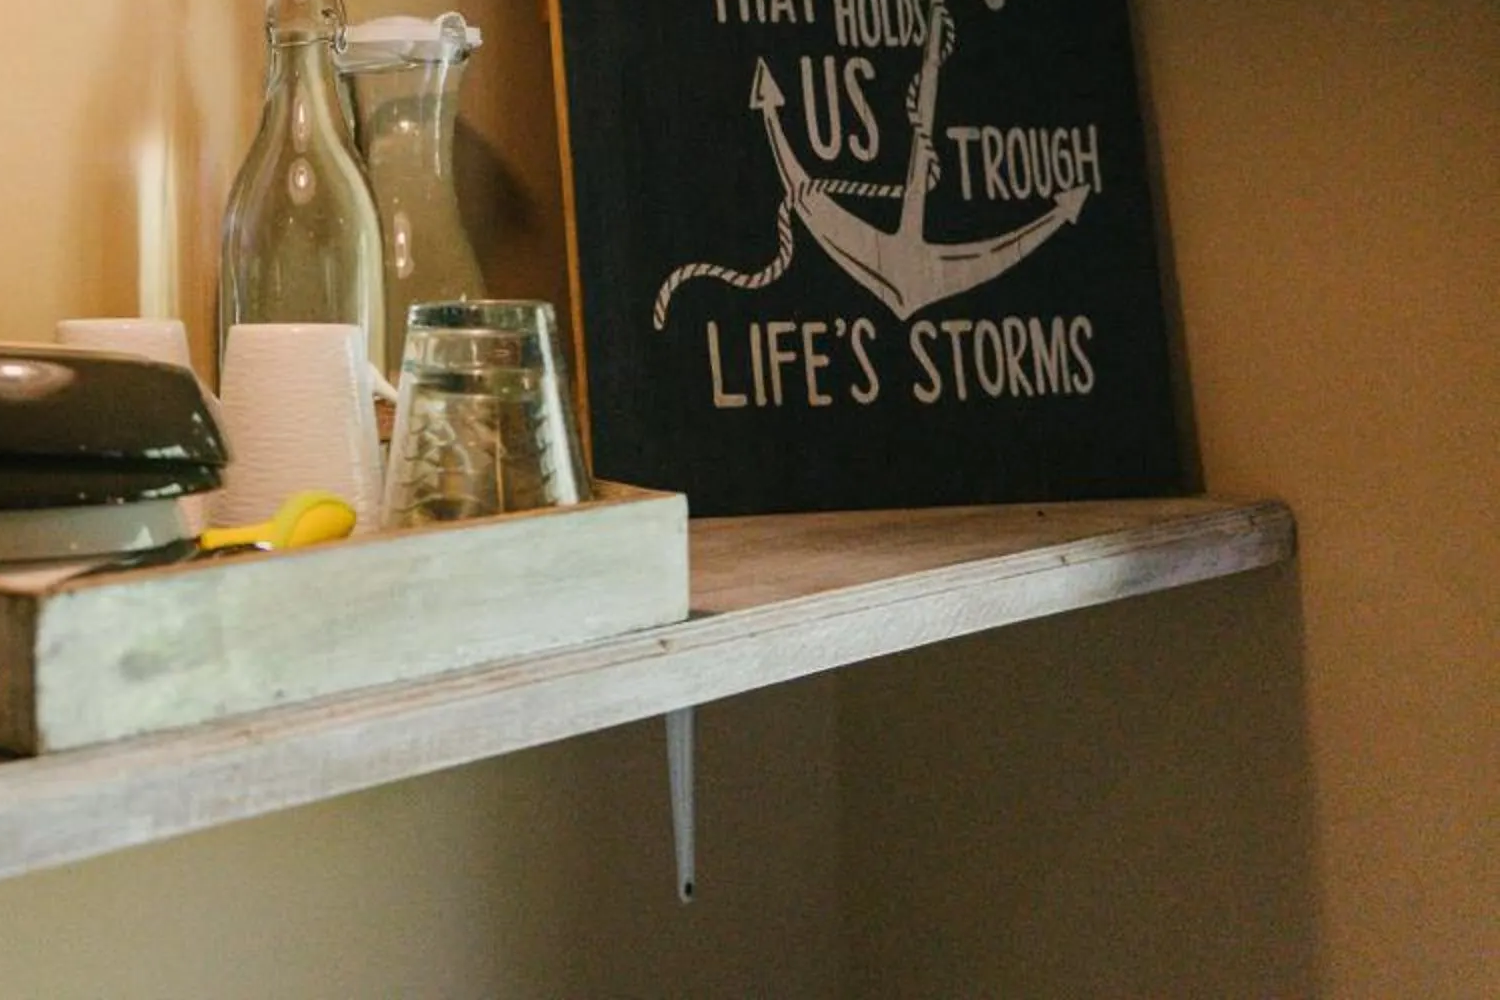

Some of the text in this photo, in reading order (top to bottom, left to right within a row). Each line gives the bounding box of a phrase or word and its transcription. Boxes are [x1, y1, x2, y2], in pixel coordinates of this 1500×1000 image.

[800, 55, 880, 162] US
[946, 124, 1102, 200] TROUGH
[707, 314, 1095, 408] LIFE'S STORMS
